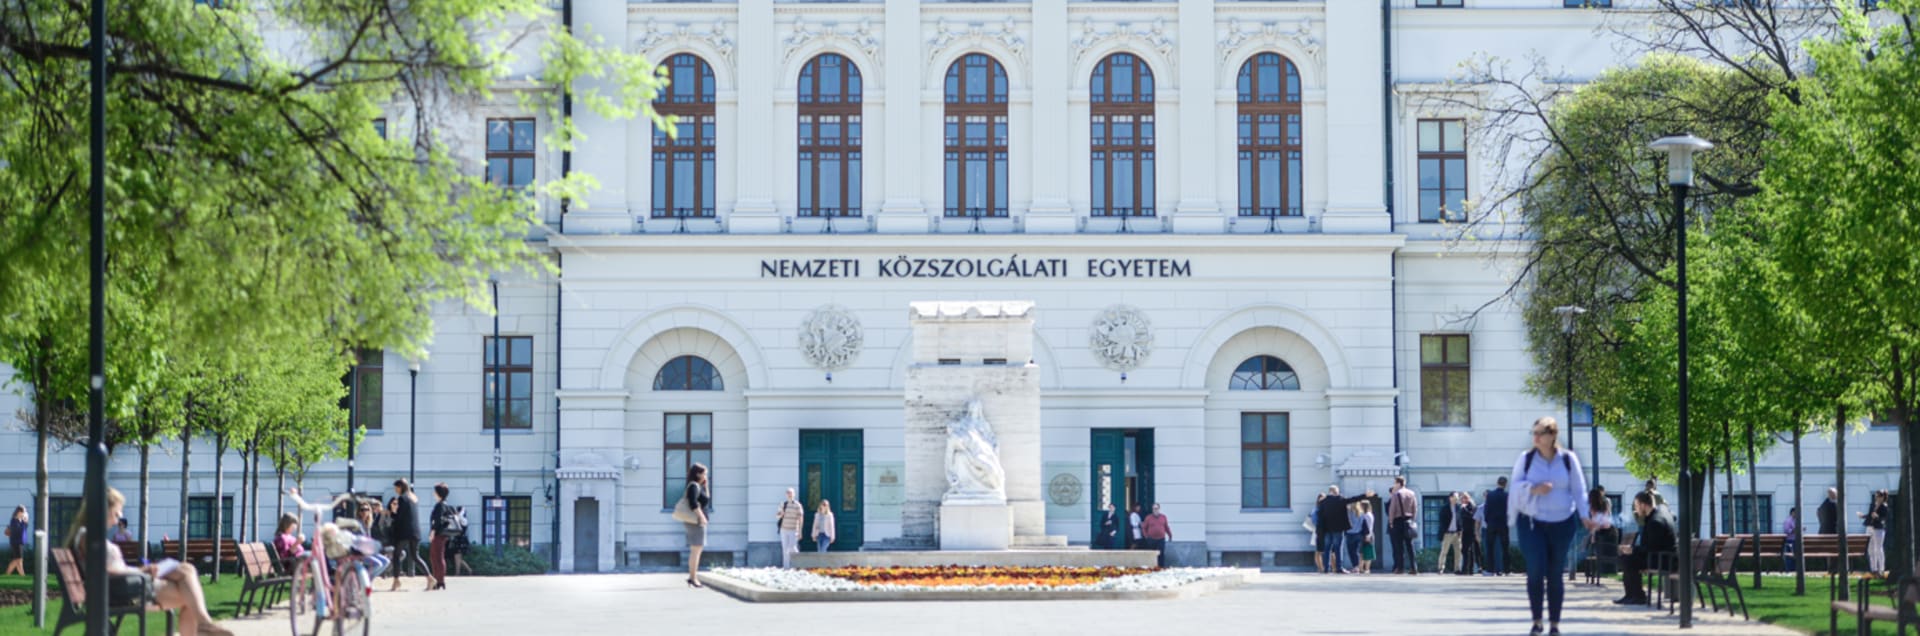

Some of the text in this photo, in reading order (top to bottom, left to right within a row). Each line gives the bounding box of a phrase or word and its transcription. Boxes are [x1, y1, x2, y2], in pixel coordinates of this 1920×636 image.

[760, 254, 1192, 278] NEMZETI KÖZSZOLGÁLATI EGYETEM
